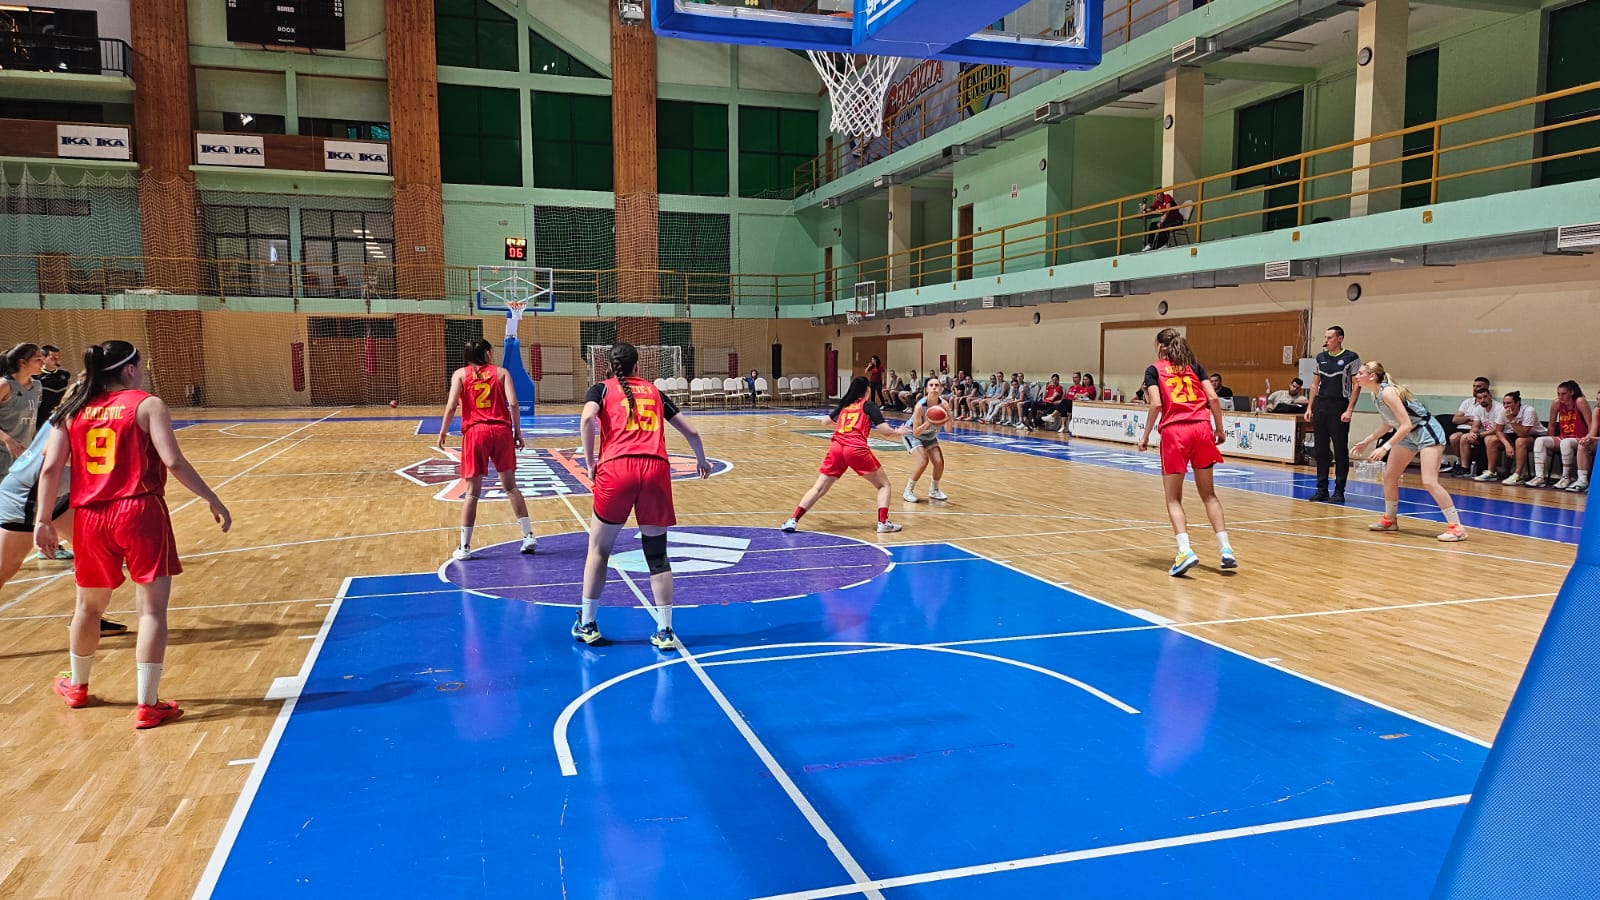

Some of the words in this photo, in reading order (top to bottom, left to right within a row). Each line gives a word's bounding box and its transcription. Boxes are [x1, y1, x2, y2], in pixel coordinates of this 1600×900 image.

[60, 136, 90, 146] IKA
[95, 138, 125, 147] IKA
[201, 145, 230, 154] IKA
[233, 146, 262, 155] IKA
[327, 151, 354, 160] IKA
[359, 153, 386, 162] IKA
[509, 247, 523, 258] 06
[474, 382, 492, 409] 2
[1165, 376, 1198, 403] 21
[83, 404, 126, 421] RADEVIĆ
[621, 398, 659, 432] 15
[838, 412, 860, 433] 17
[1255, 431, 1292, 444] ЧАЈЕТИНА
[86, 427, 116, 475] 9
